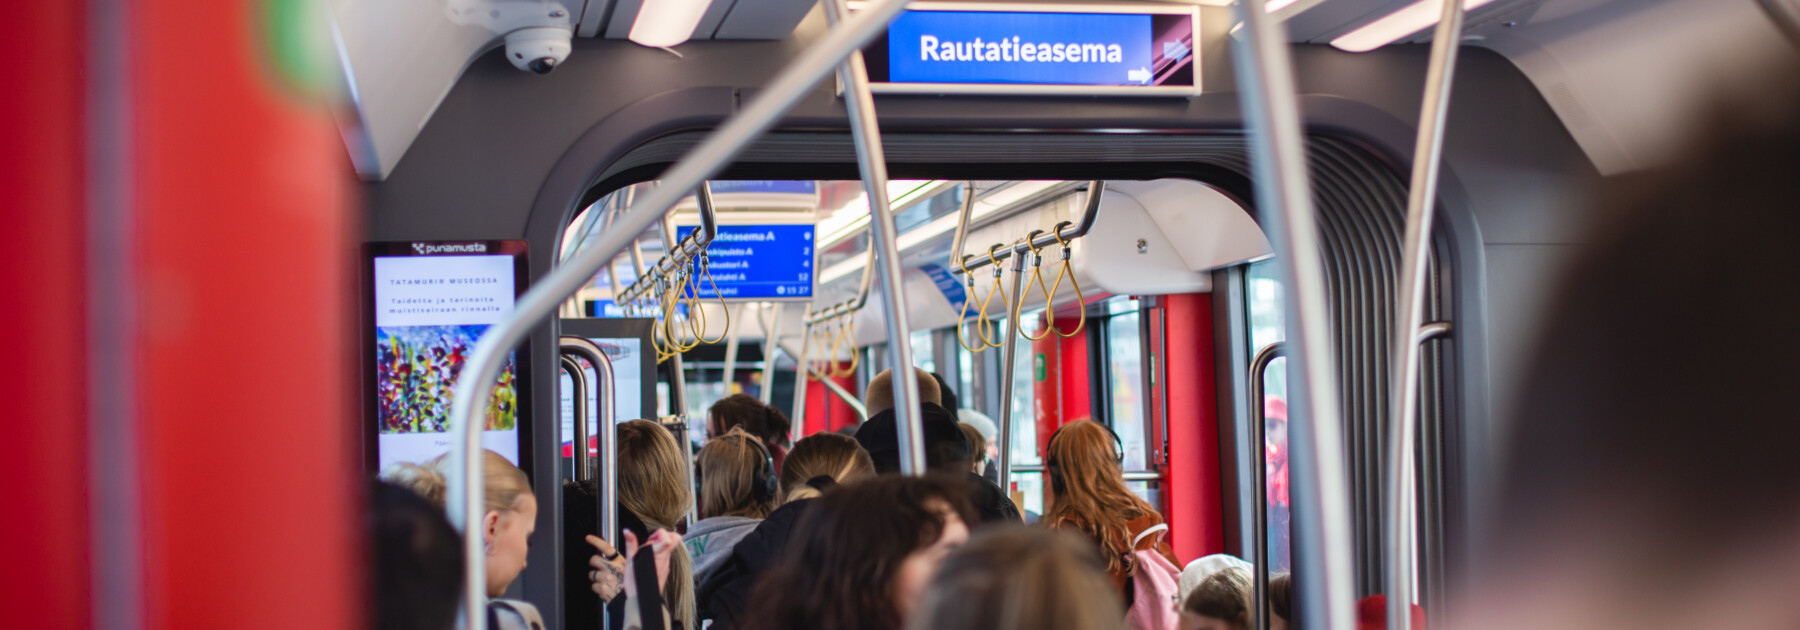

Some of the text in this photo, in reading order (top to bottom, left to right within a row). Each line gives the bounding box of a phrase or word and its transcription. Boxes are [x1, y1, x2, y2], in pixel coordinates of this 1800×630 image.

[920, 35, 1122, 63] Rautatieasema
[766, 231, 775, 241] A
[426, 243, 487, 253] punamusta
[746, 247, 753, 256] A
[803, 246, 810, 256] 2
[742, 261, 749, 269] A
[802, 260, 809, 268] 4
[739, 273, 746, 281] A
[799, 272, 809, 281] 12
[436, 297, 445, 305] ja
